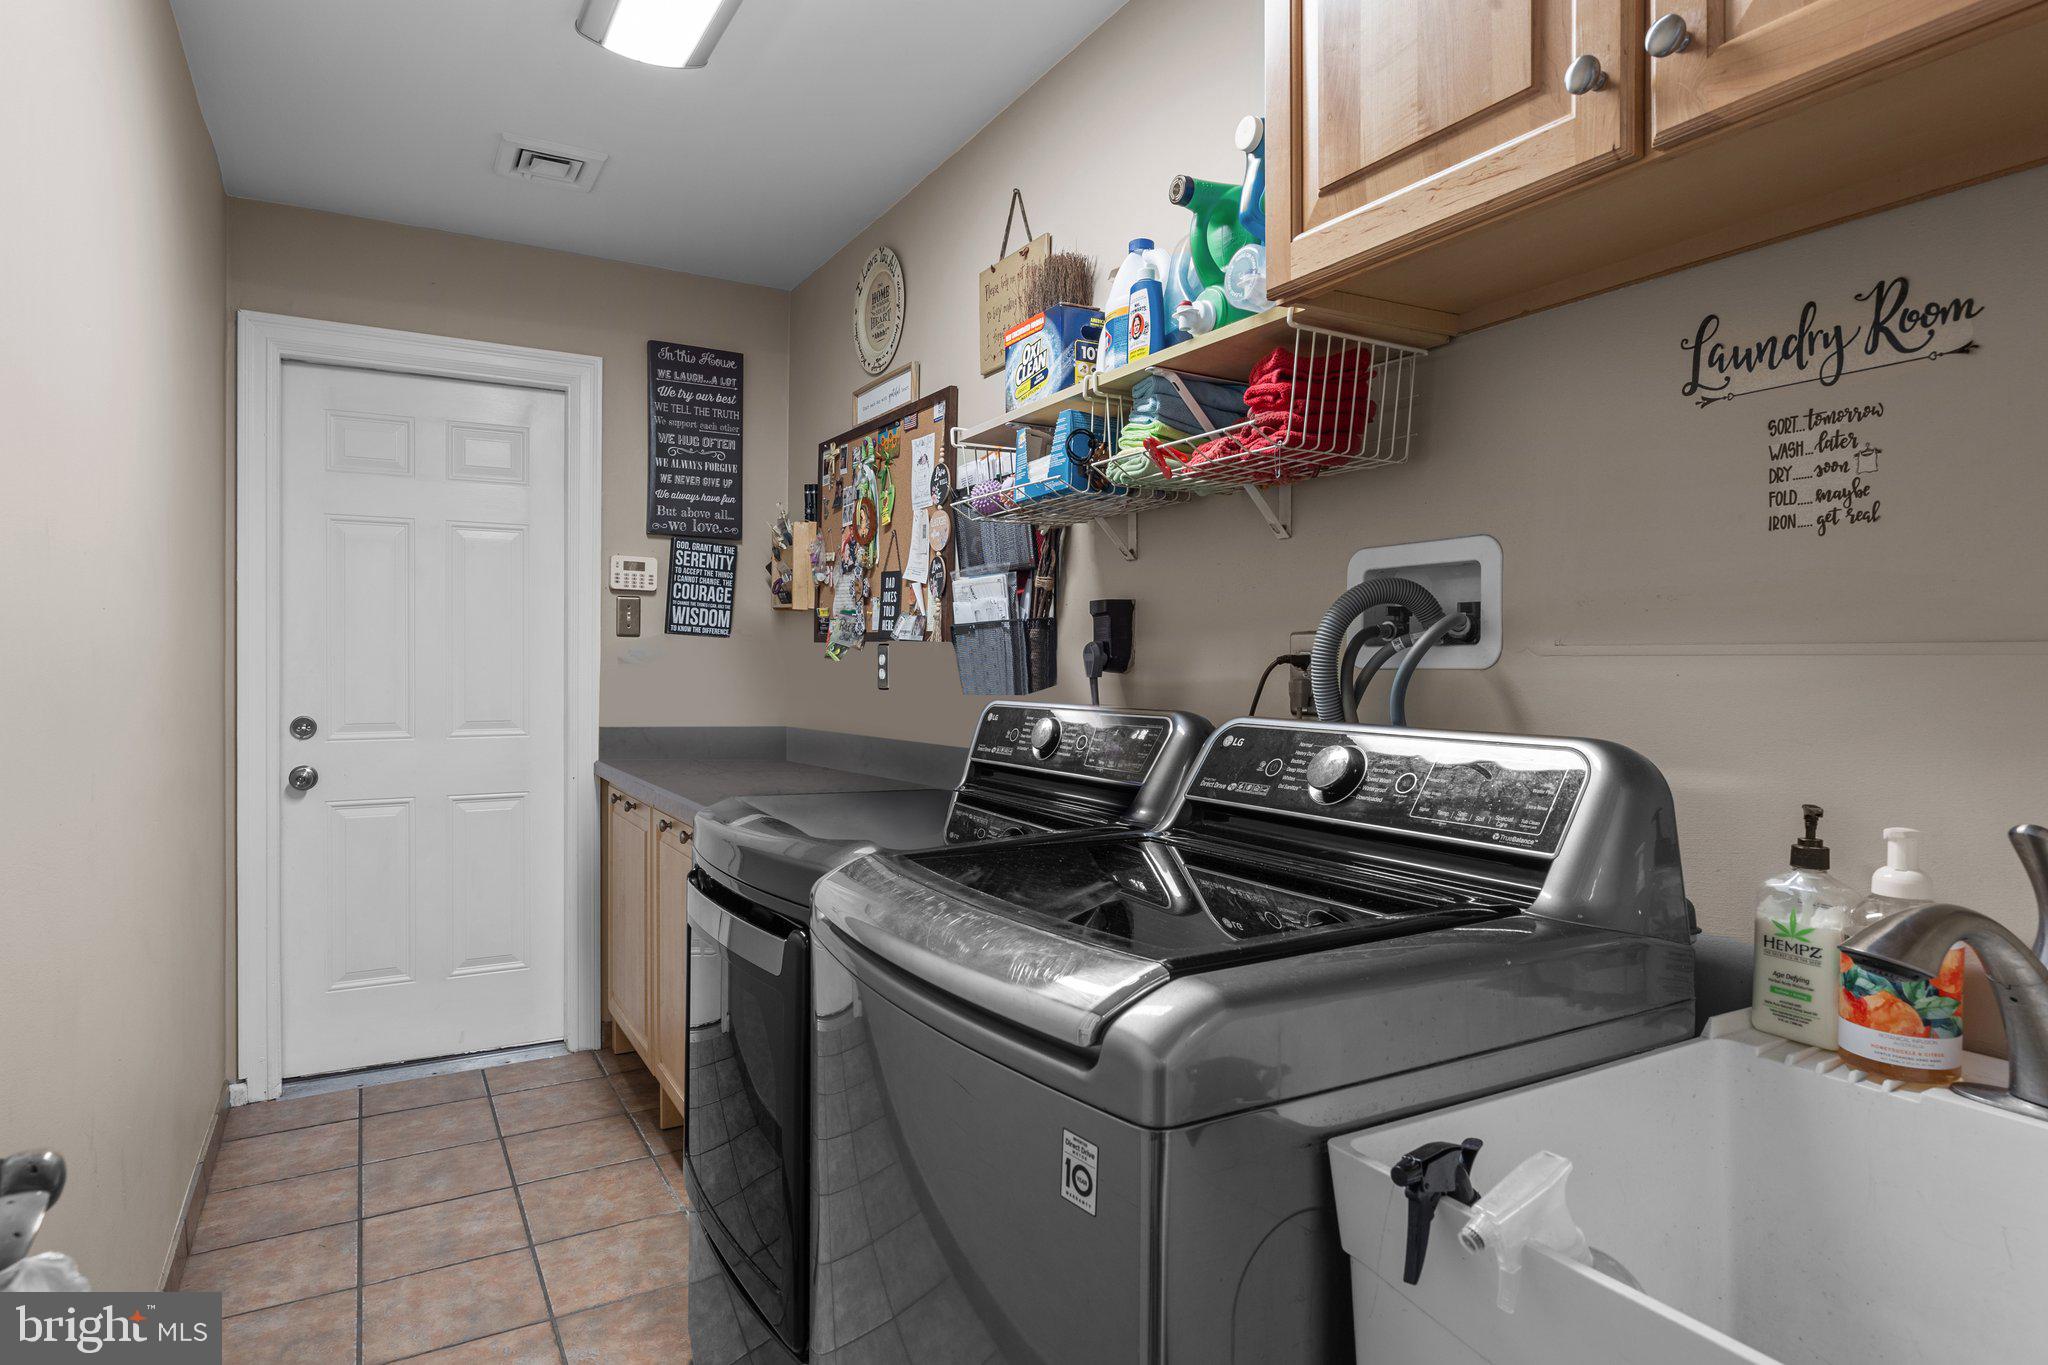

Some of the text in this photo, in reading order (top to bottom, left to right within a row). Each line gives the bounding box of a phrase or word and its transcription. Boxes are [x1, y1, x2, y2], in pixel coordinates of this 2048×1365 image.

[872, 285, 890, 305] HOME
[871, 307, 892, 330] HEART
[1681, 276, 1985, 397] Laundry Room
[658, 347, 738, 370] In this House
[1022, 339, 1041, 366] OXI
[1015, 349, 1047, 387] CLEAN
[657, 369, 671, 379] WE
[720, 377, 736, 387] LOT
[657, 386, 737, 405] We try our best
[654, 402, 740, 420] WE TELL THE TRUTH
[654, 415, 740, 432] We support each other
[657, 432, 736, 450] WE HUG OFTEN
[1814, 429, 1859, 453] later
[655, 457, 738, 473] WE ALWAYS FORGIVE
[1814, 461, 1850, 478] soon
[660, 473, 733, 489] WE NEVER GIVE UP
[655, 488, 736, 505] We always have fun
[1815, 477, 1871, 509] maybe
[656, 504, 678, 517] But
[680, 507, 711, 519] above
[1816, 506, 1841, 537] get
[1845, 500, 1881, 525] real
[668, 518, 722, 534] we love.
[676, 540, 735, 555] GOD, GRANT ME THE
[675, 550, 735, 571] SERENITY
[675, 566, 734, 579] TO ACCEPT THE THINGS
[677, 575, 698, 584] CANNOT
[722, 579, 733, 587] THE
[885, 576, 896, 589] DAD
[672, 582, 733, 604] COURAGE
[882, 591, 898, 603] JOKES
[671, 605, 731, 628] WISDOM
[883, 605, 896, 617] TOLD
[692, 626, 702, 634] THE
[881, 619, 894, 631] HERE
[1231, 737, 1246, 747] LG
[1200, 780, 1227, 790] Direct Drive
[1763, 934, 1824, 959] HEMPZ
[1772, 970, 1810, 985] Age Defying
[1065, 1138, 1096, 1160] Direct Drive
[1065, 1157, 1093, 1198] 10
